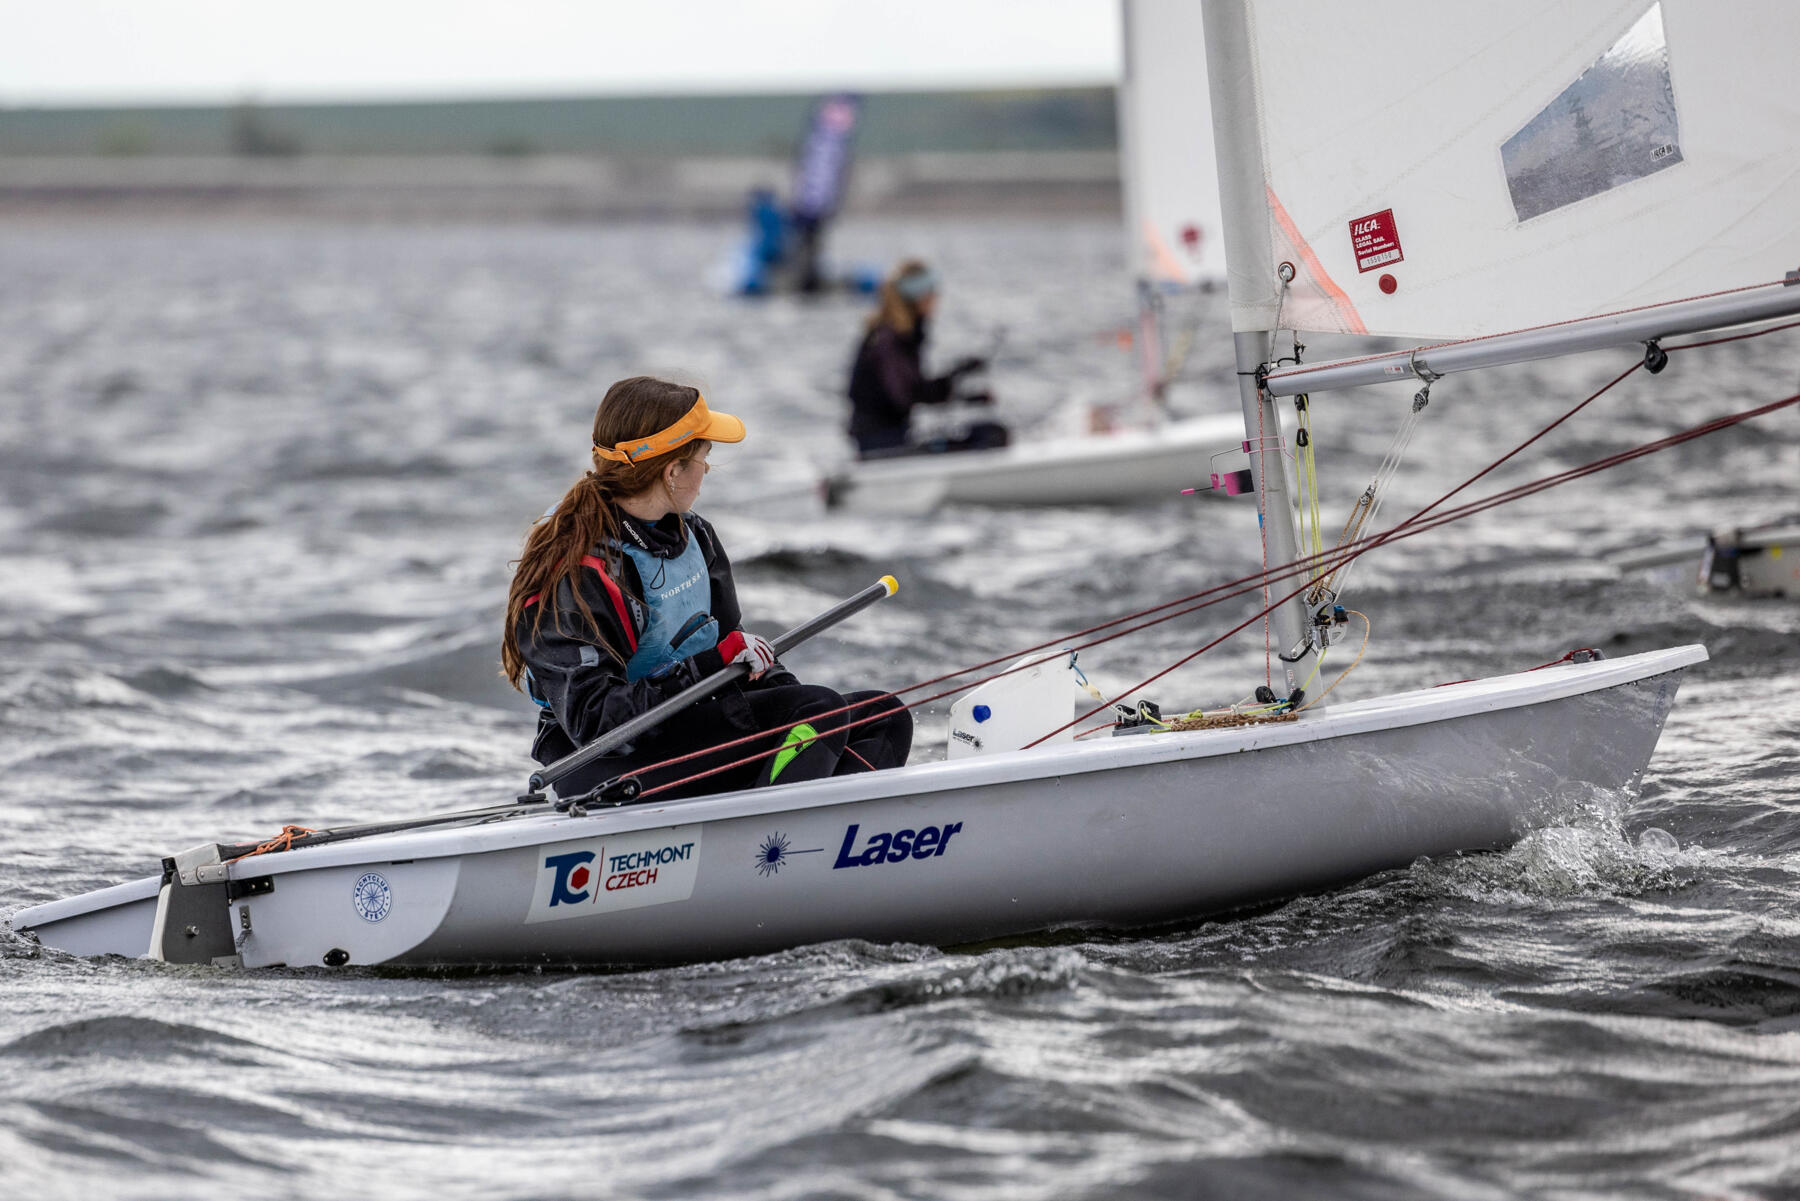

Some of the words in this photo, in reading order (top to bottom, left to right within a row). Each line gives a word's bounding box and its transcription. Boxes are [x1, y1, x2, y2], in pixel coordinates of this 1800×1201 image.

[1354, 219, 1378, 236] ILCA
[1355, 234, 1371, 243] CLASS
[1356, 240, 1373, 249] LEGAL
[623, 520, 648, 549] ROOSTER
[660, 579, 692, 601] NORTH
[952, 728, 975, 742] Laser
[833, 822, 963, 869] Laser
[609, 842, 695, 874] TECHMONT
[355, 875, 389, 898] YACHTCLUB
[606, 868, 658, 892] CZECH
